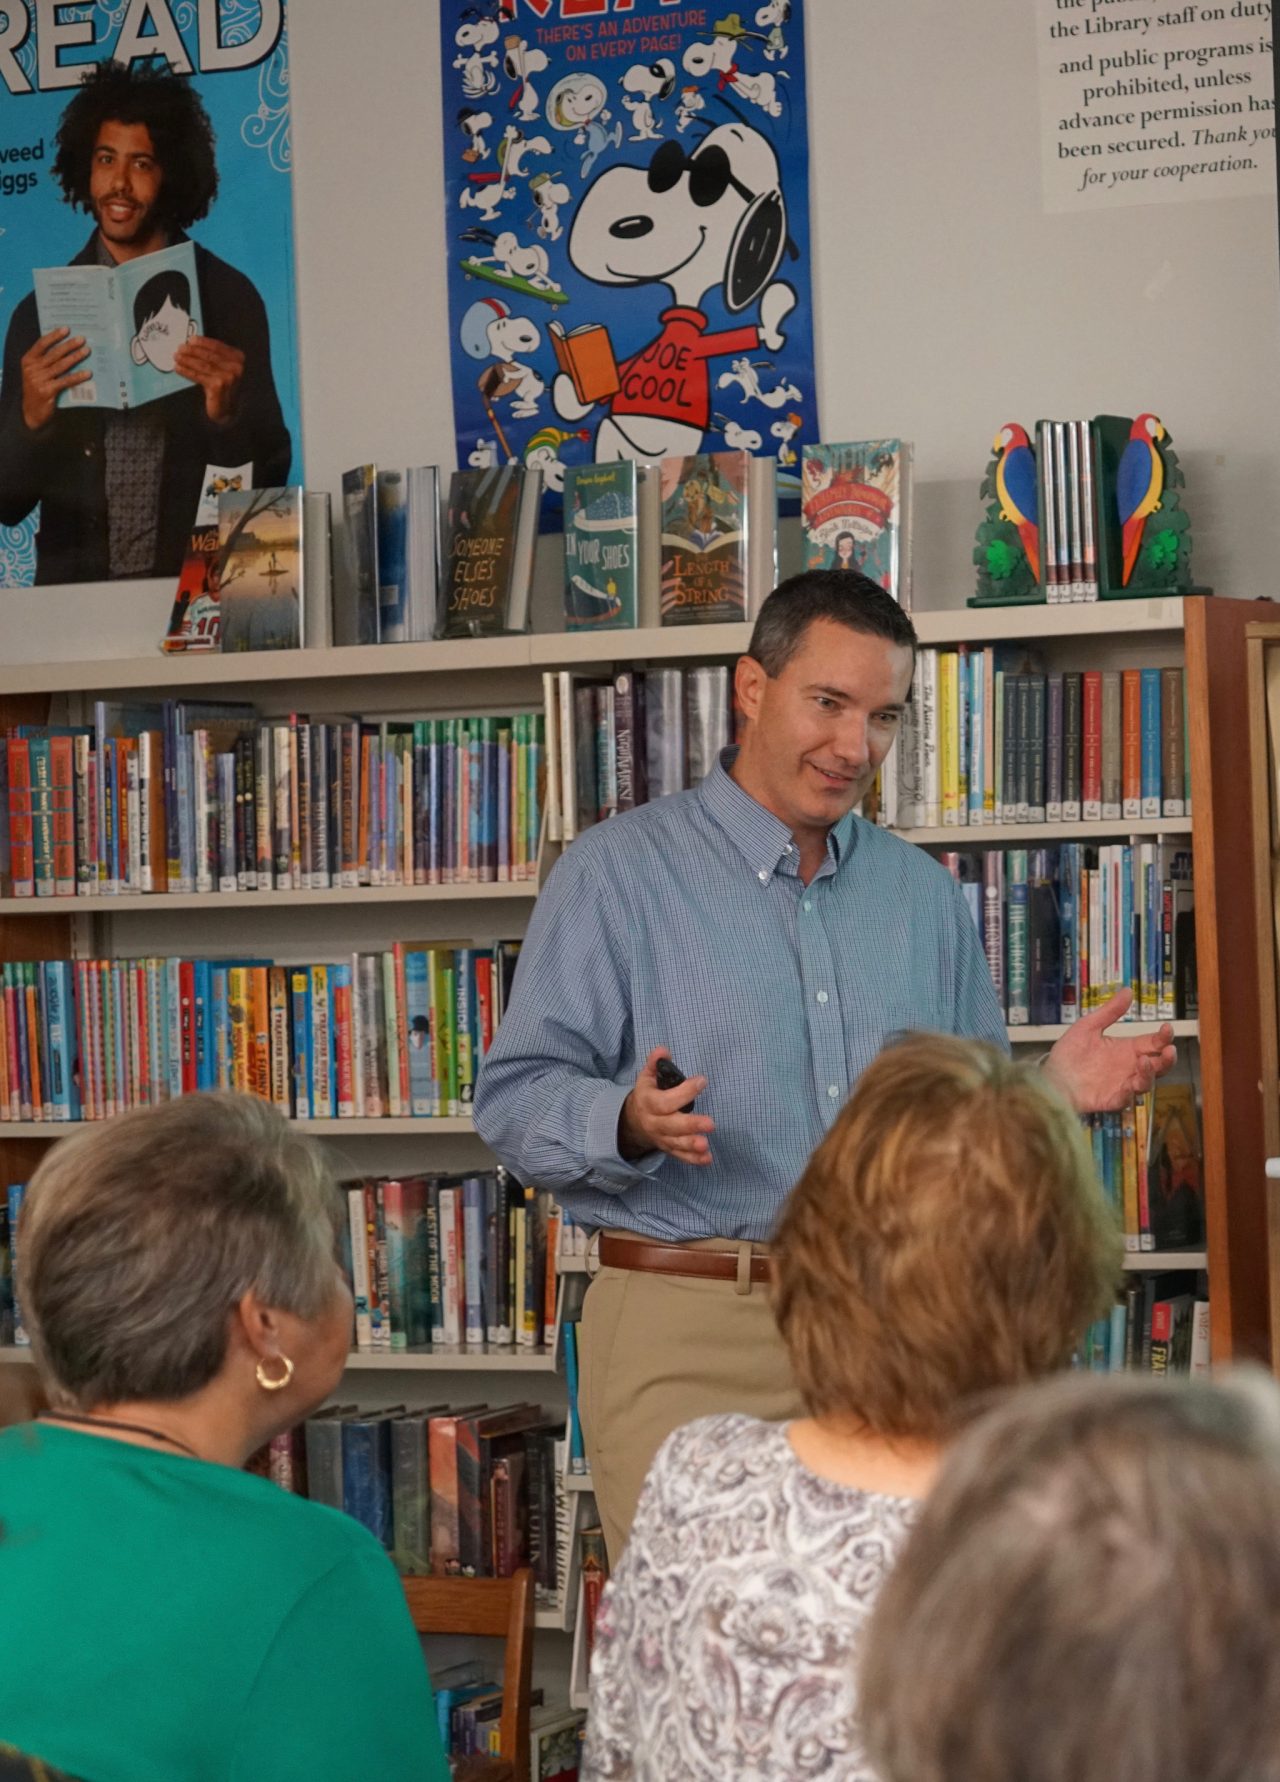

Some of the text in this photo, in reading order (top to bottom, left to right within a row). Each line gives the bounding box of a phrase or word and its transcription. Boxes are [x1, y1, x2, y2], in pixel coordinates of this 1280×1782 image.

[536, 24, 594, 46] THERE'S
[598, 22, 619, 39] AN
[623, 9, 707, 36] ADVENTURE
[1050, 21, 1080, 39] the
[1085, 16, 1151, 36] Library
[1157, 6, 1197, 27] staff
[1200, 8, 1225, 23] on
[1231, 0, 1272, 22] duty
[566, 34, 682, 62] ON EVERY PAGE!
[1059, 54, 1094, 74] and
[1099, 49, 1159, 76] public
[1164, 40, 1254, 70] programs
[1083, 69, 1252, 107] prohibited, unless
[1058, 111, 1135, 131] advance
[1140, 100, 1243, 130] permission
[1058, 142, 1102, 159] been
[1107, 131, 1186, 155] secured.
[1192, 125, 1248, 146] Thank
[1077, 155, 1259, 192] for your cooperation.
[643, 342, 693, 372] JOE
[624, 373, 692, 408] COOL
[447, 533, 505, 560] SOMEONE
[565, 532, 630, 571] IN YOUR SHOES
[447, 585, 498, 611] SHOES
[457, 988, 467, 1033] INSIDE
[427, 1207, 440, 1304] WEST OF THE MOON
